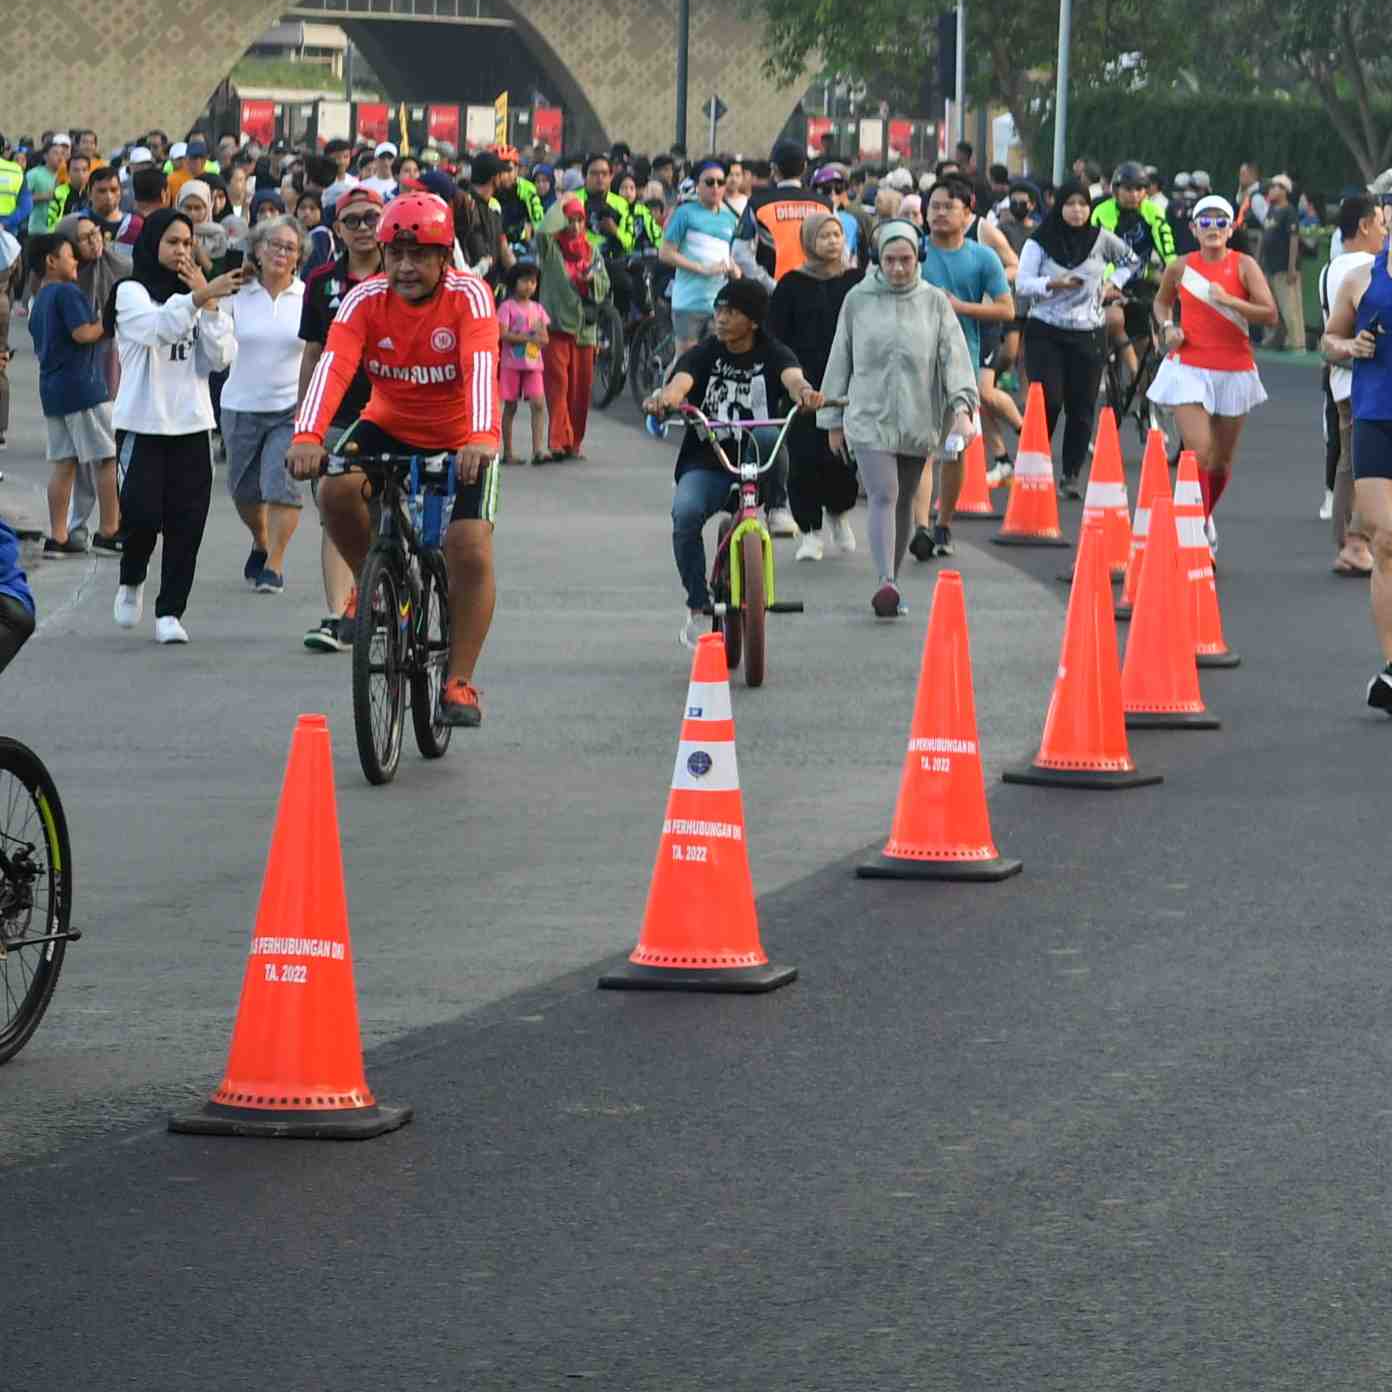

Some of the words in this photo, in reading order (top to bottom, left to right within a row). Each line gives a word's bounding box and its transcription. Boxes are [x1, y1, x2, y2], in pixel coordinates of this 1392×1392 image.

[368, 359, 457, 385] SAMSUNG
[686, 845, 708, 862] 2022
[259, 937, 331, 958] PERHUBUNGAN
[281, 965, 307, 983] 2022
